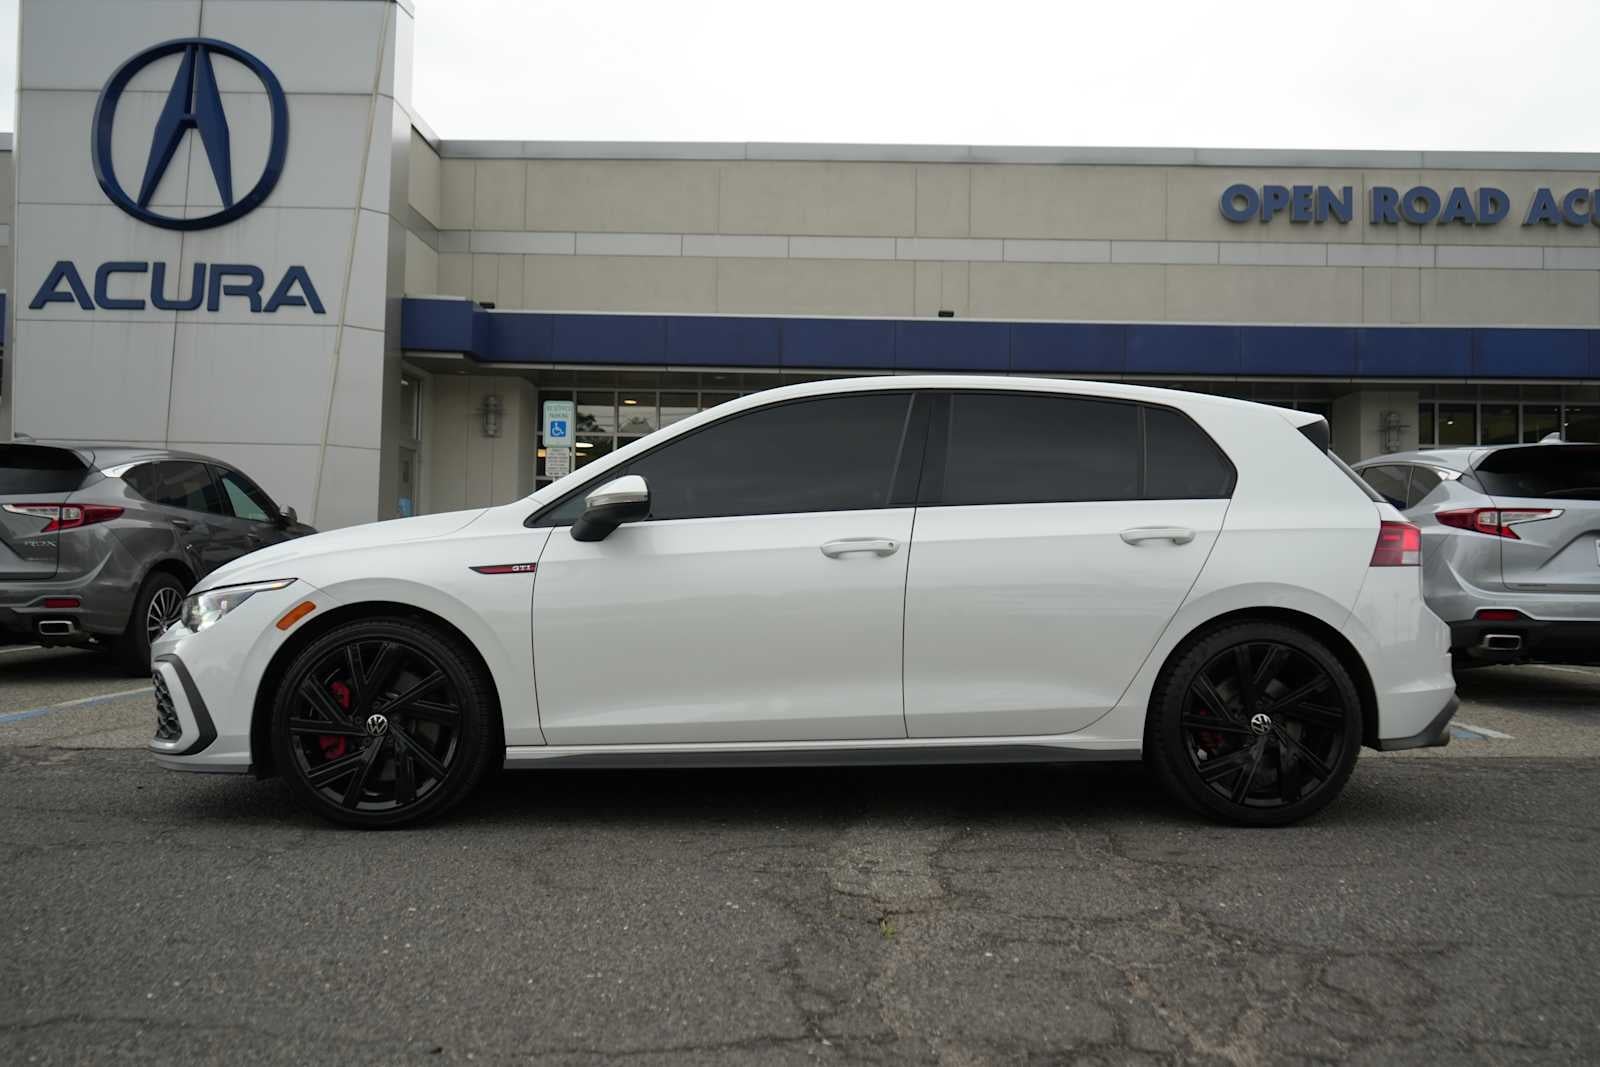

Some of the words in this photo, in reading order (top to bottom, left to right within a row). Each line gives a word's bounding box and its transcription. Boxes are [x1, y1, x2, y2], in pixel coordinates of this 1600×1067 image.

[1221, 184, 1352, 223] OPEN
[1370, 186, 1510, 225] ROAD
[1522, 188, 1600, 227] AC
[29, 260, 326, 314] ACURA
[511, 564, 531, 572] GTI
